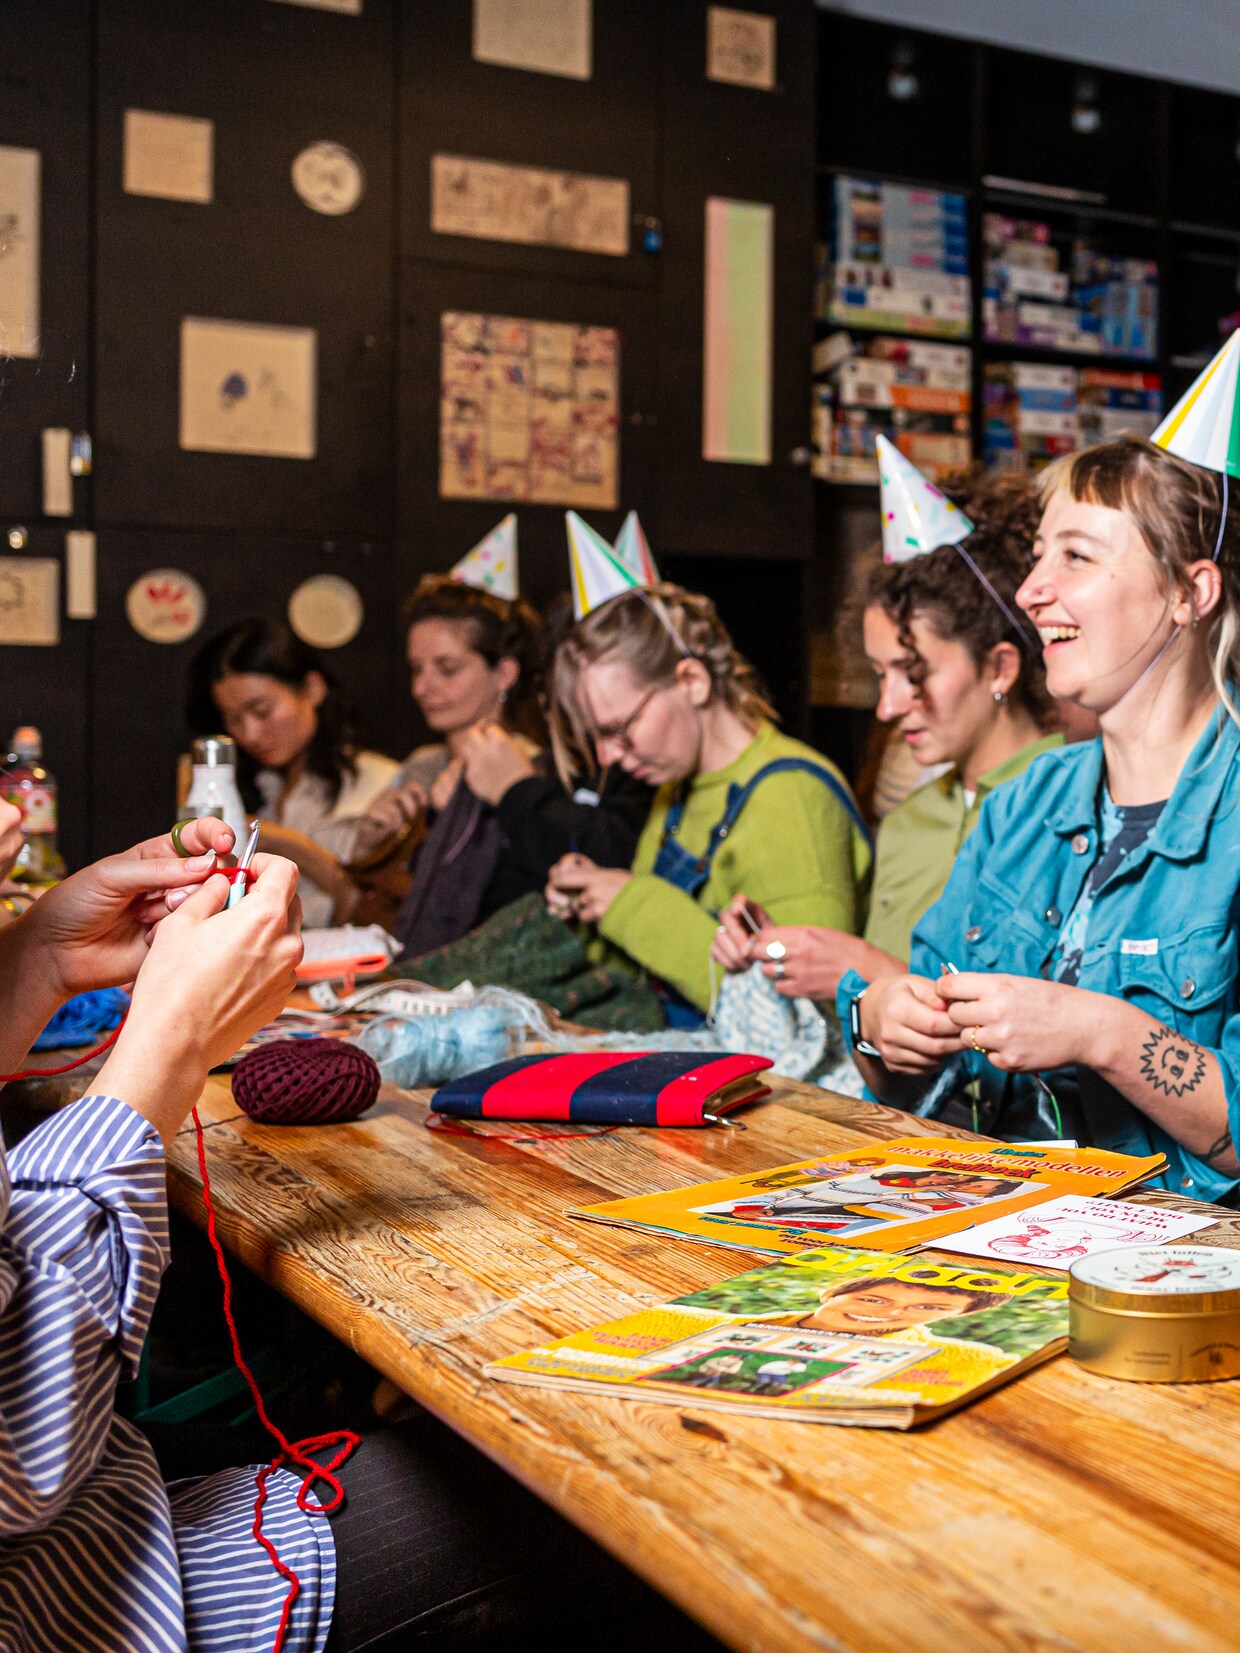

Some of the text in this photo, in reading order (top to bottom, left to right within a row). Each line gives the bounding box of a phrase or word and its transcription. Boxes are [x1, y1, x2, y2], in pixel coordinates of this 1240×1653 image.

[887, 1145, 1129, 1179] makkelijke modellen
[926, 1159, 1042, 1179] breiboek
[780, 1249, 1070, 1300] ariadn
